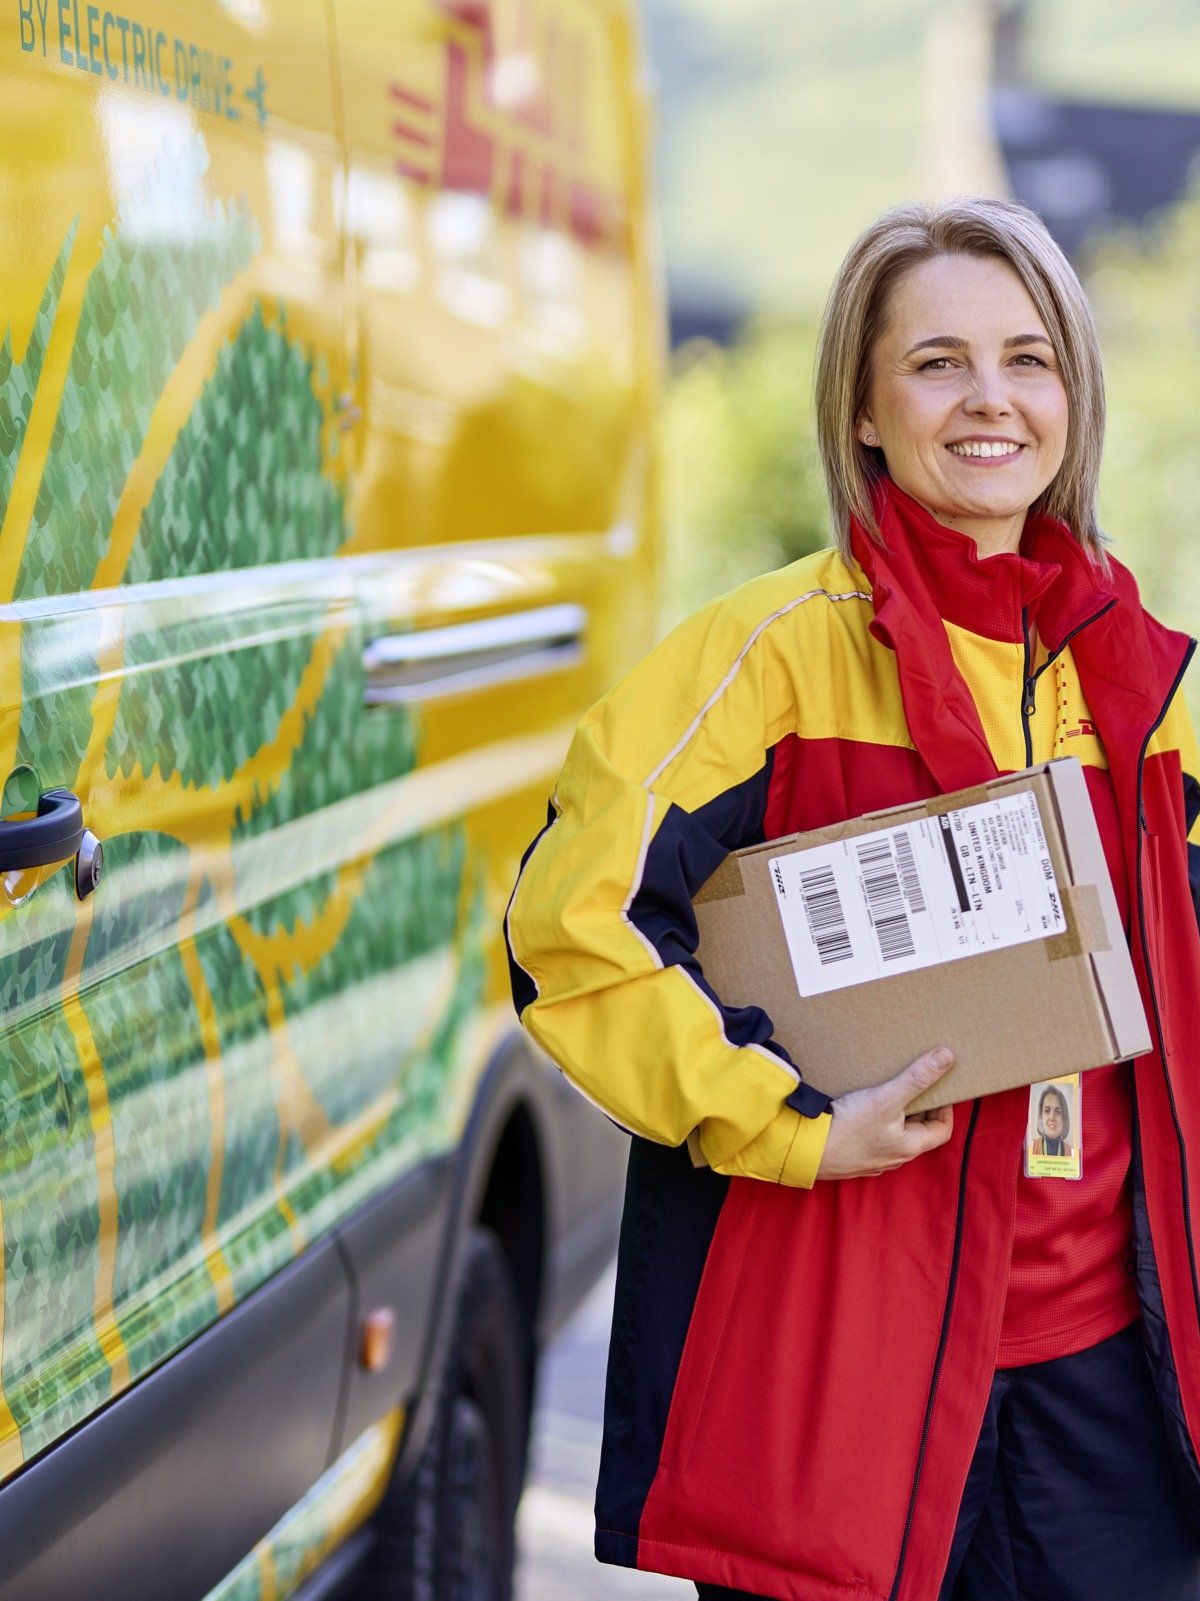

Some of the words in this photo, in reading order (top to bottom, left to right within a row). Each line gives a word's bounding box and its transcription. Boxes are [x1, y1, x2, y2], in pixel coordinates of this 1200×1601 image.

[19, 0, 47, 57] BY
[57, 0, 170, 97] ELECTRIC
[173, 35, 241, 122] DRIVE
[967, 821, 981, 852] UNITED
[976, 854, 992, 894] KINGDOM
[1040, 857, 1053, 880] DOM
[773, 866, 785, 894] DHL
[1048, 891, 1061, 921] DHL
